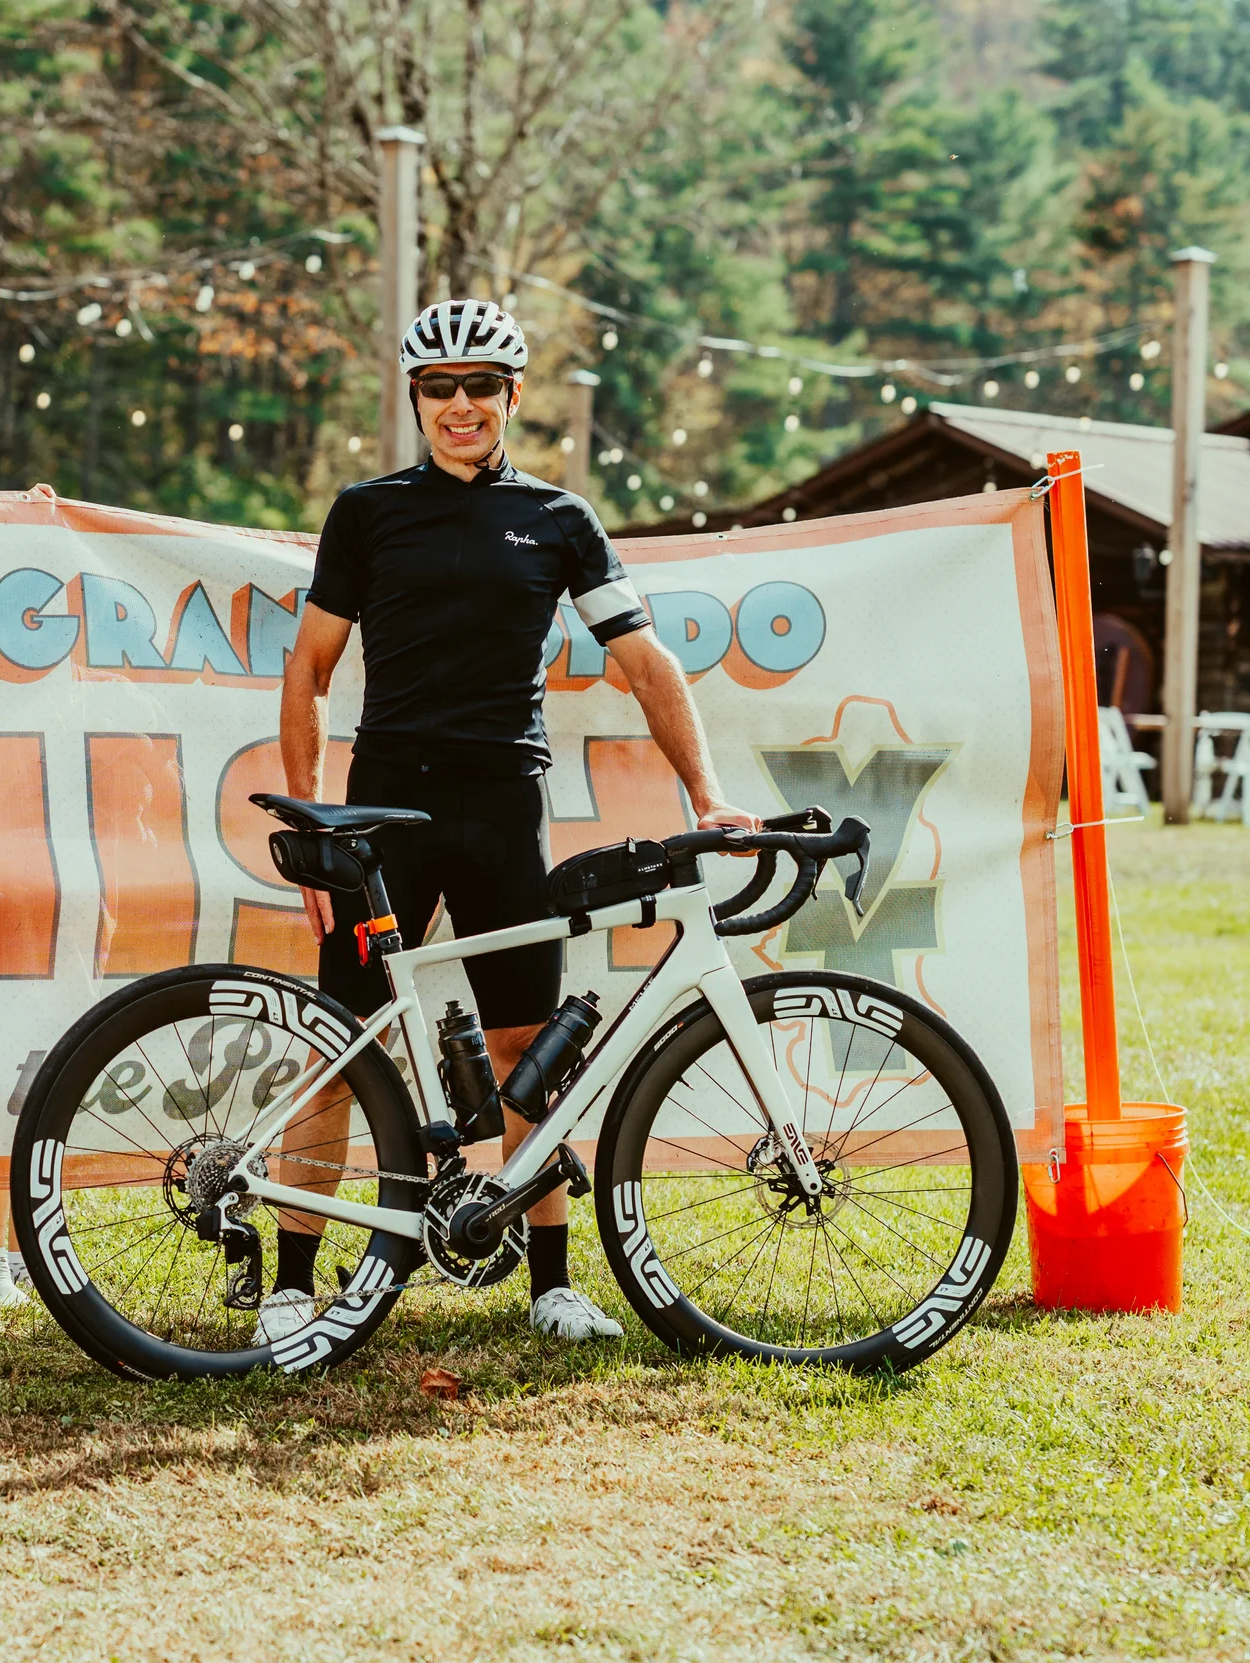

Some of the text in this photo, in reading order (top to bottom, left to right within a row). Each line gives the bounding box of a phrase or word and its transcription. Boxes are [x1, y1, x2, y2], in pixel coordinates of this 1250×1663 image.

[504, 530, 539, 546] Rapha.
[243, 971, 317, 1000] CONTINENTAL
[928, 1286, 983, 1348] CONTINENTAL
